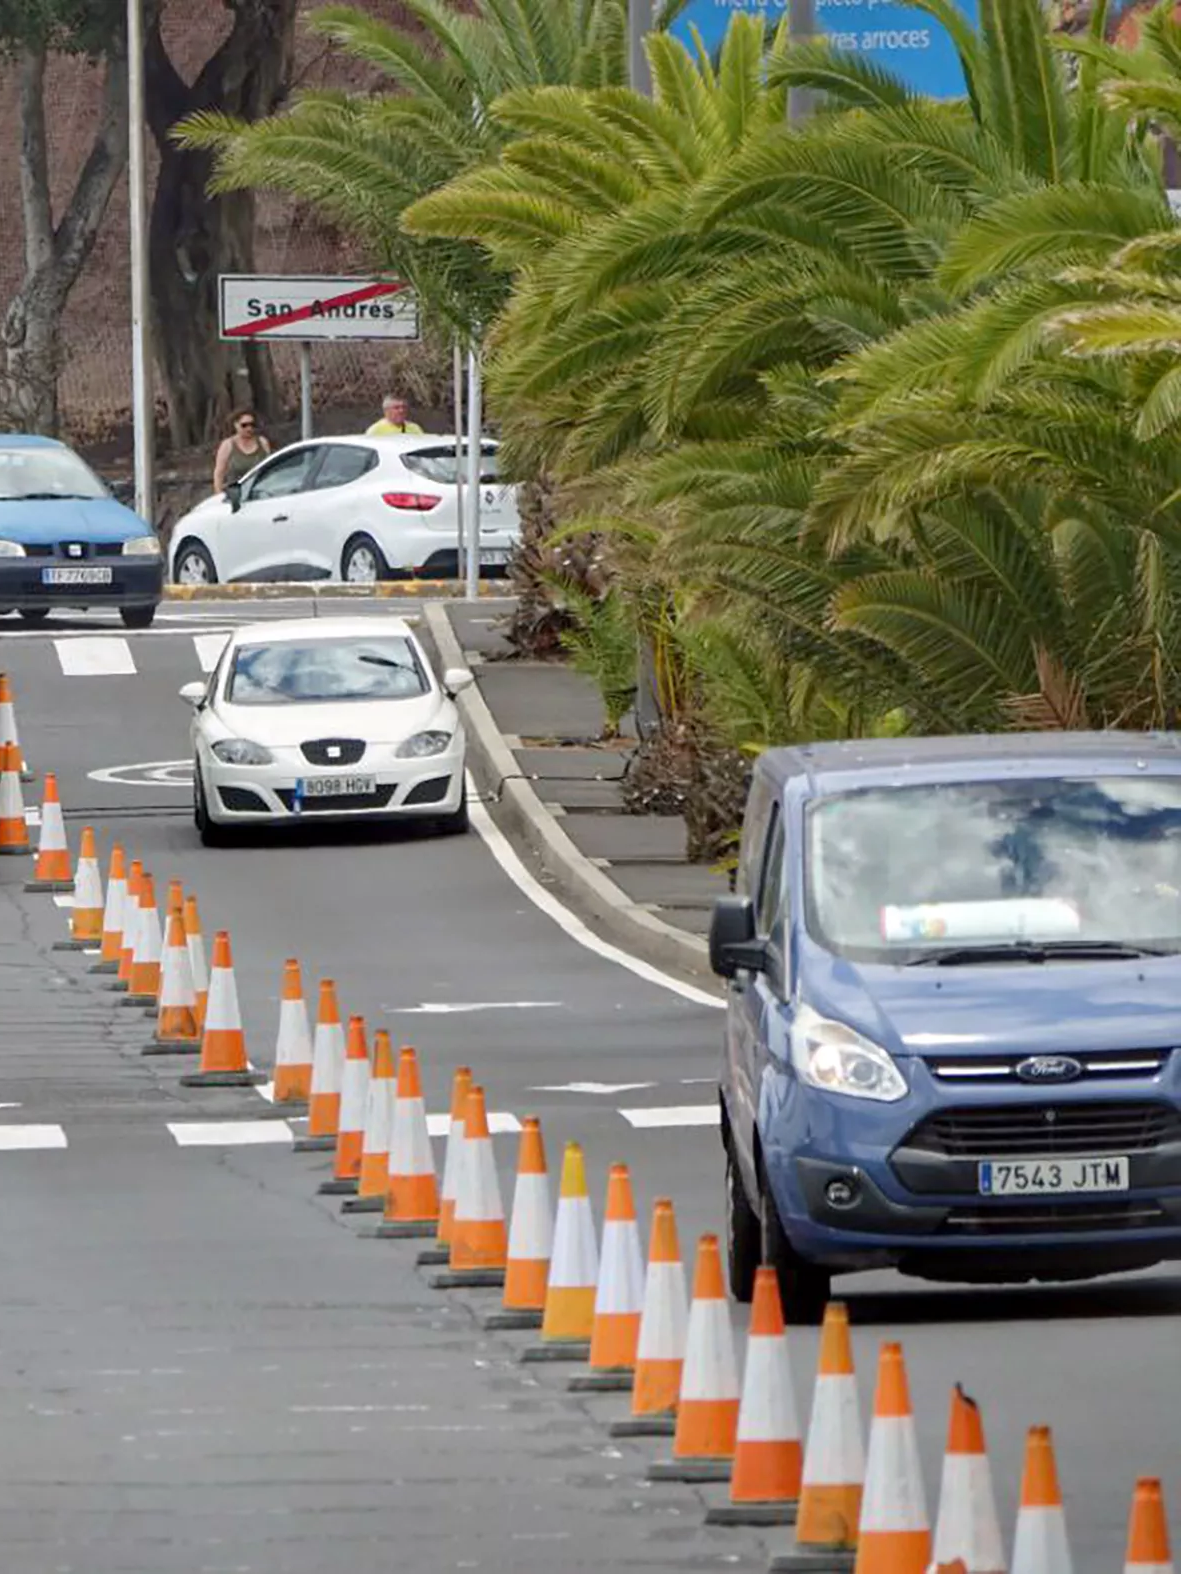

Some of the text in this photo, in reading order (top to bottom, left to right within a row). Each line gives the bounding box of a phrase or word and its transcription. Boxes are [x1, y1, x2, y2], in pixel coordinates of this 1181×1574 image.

[861, 29, 931, 50] arroces
[247, 298, 293, 319] San
[997, 1161, 1122, 1190] 7543 JTM
